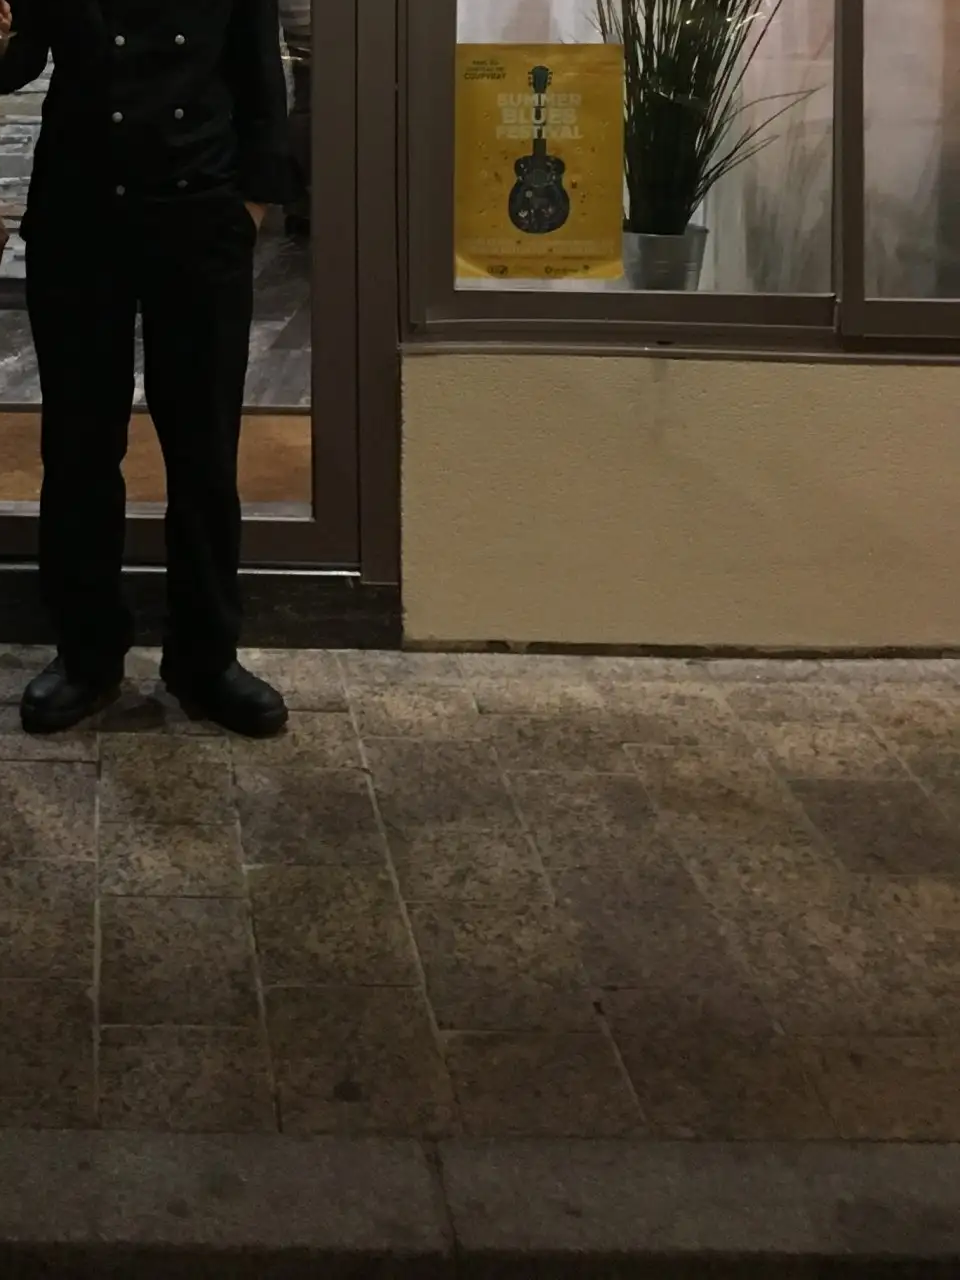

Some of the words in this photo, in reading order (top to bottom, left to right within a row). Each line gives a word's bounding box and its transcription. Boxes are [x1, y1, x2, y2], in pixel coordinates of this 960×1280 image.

[496, 93, 582, 107] SUMMER
[501, 108, 578, 124] BLUES
[496, 125, 585, 140] FESTIVAL
